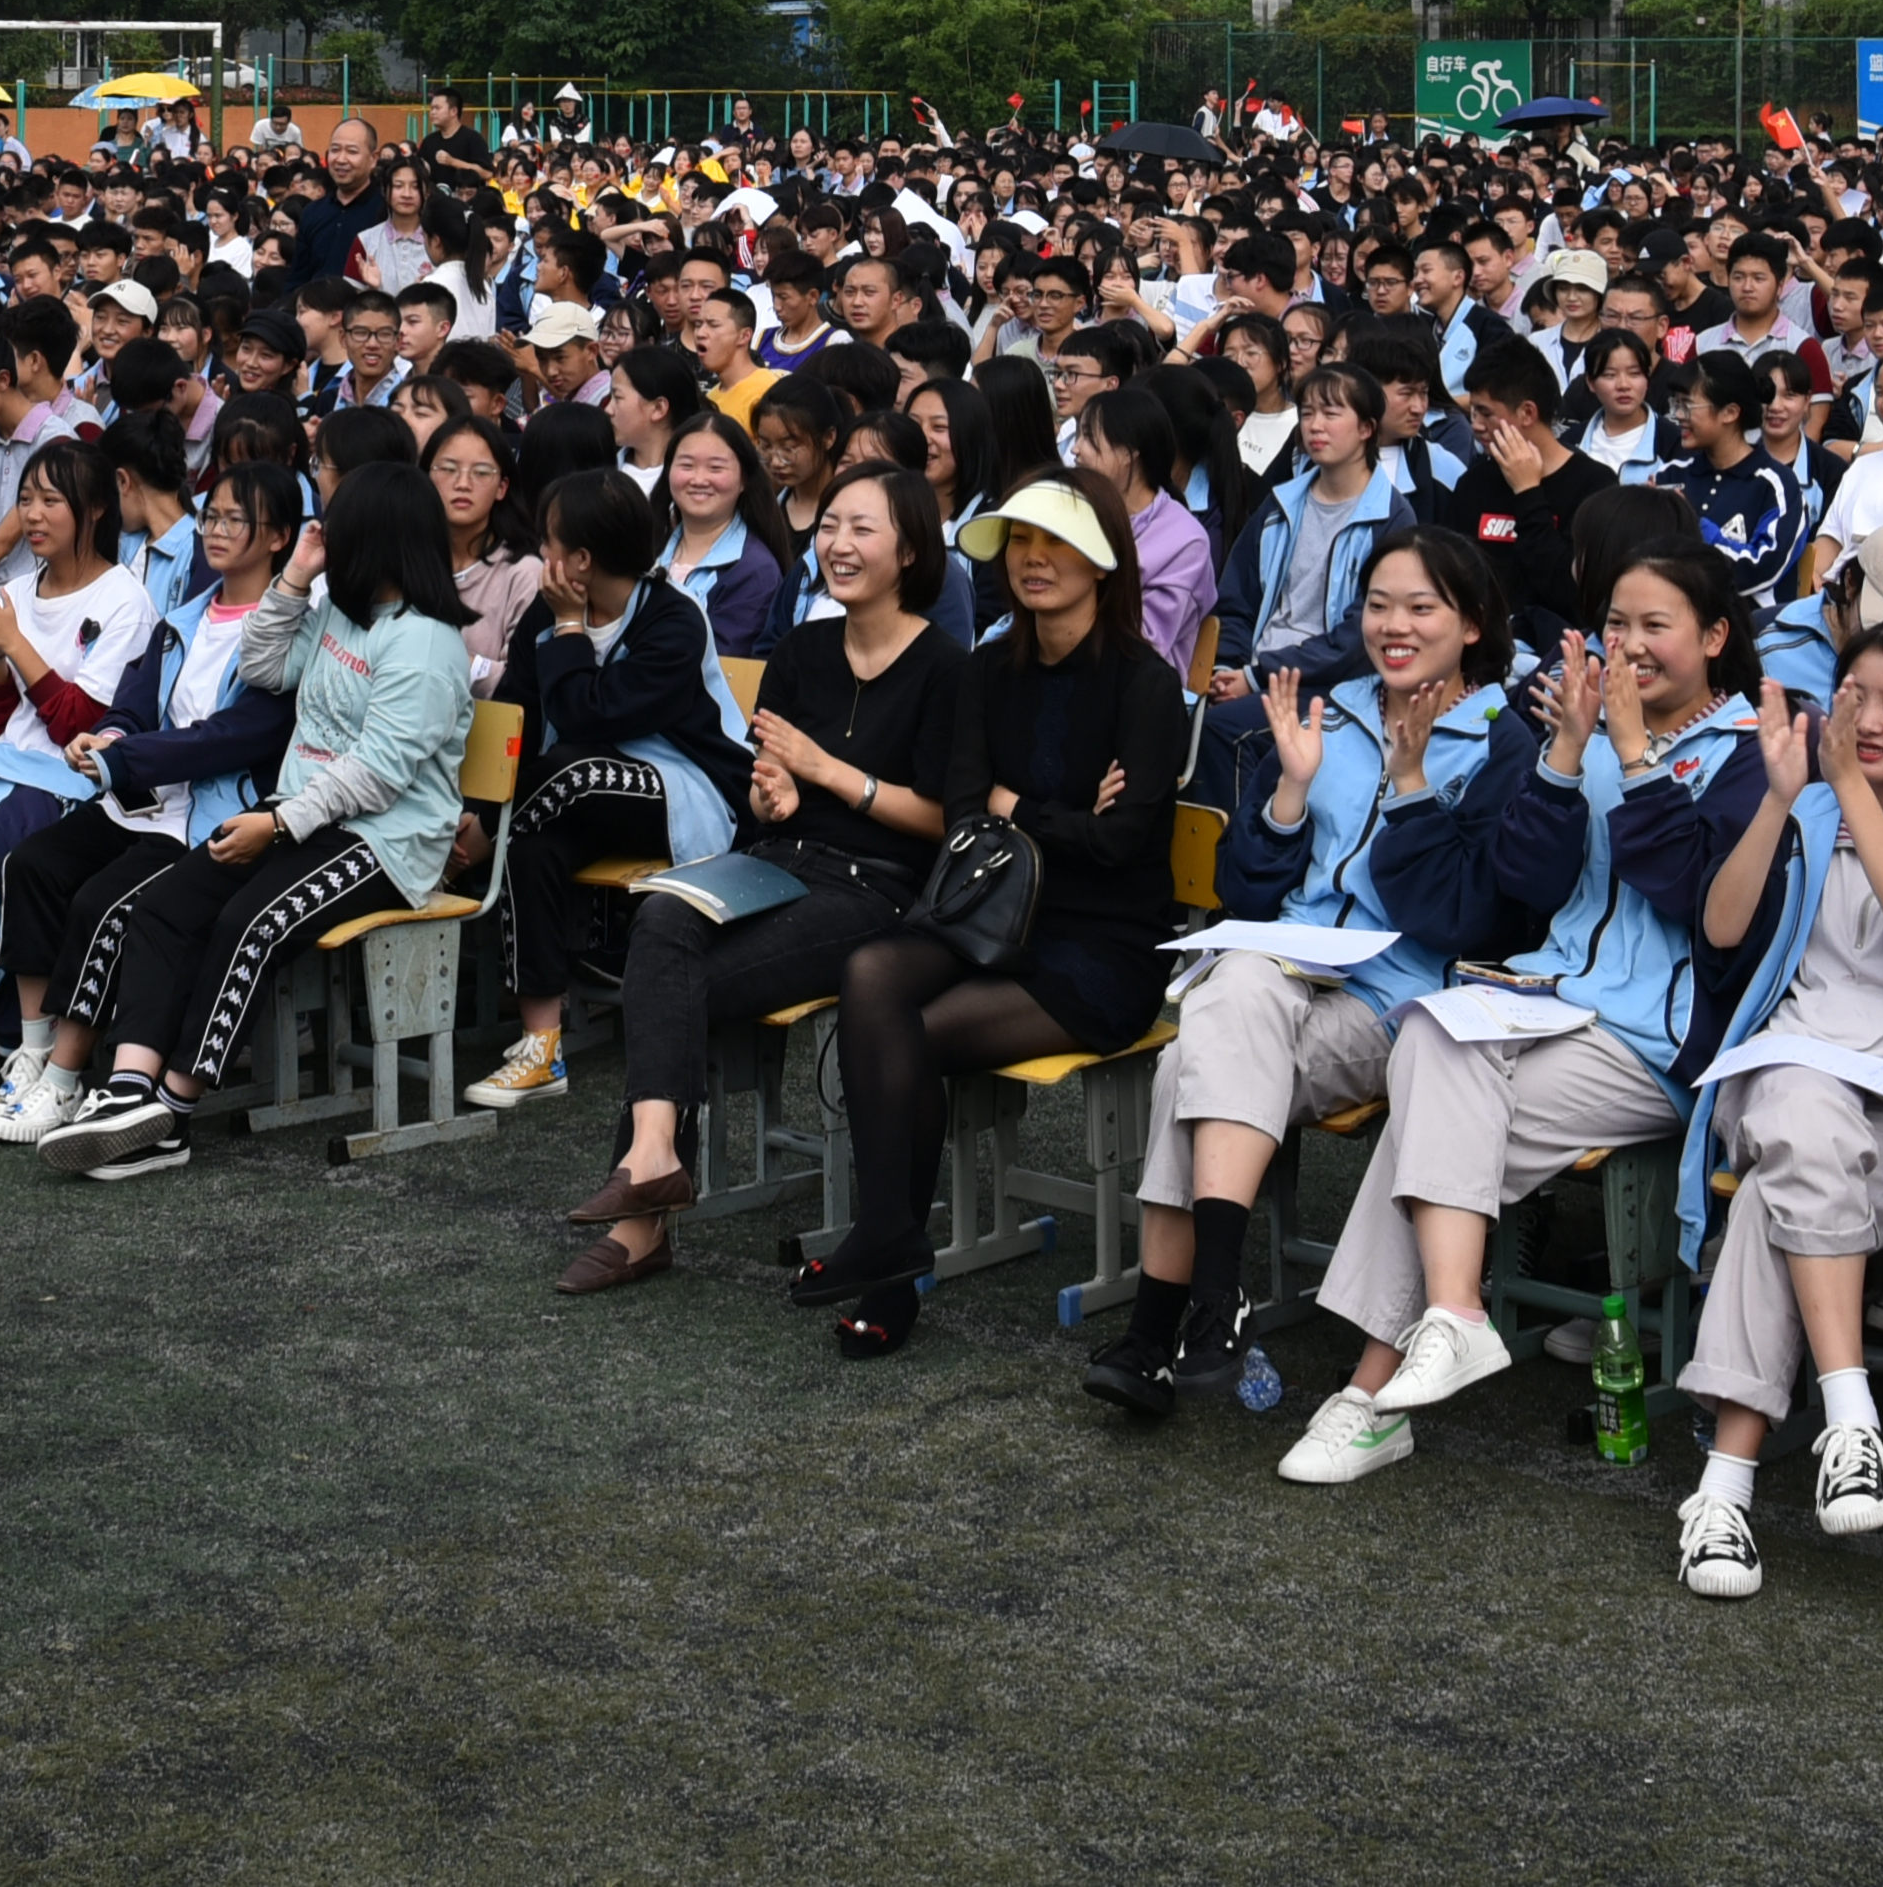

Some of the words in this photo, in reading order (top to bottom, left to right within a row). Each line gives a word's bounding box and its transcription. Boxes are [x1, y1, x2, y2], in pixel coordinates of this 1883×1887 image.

[1426, 56, 1467, 72] 自行车
[1426, 74, 1451, 83] Cycling
